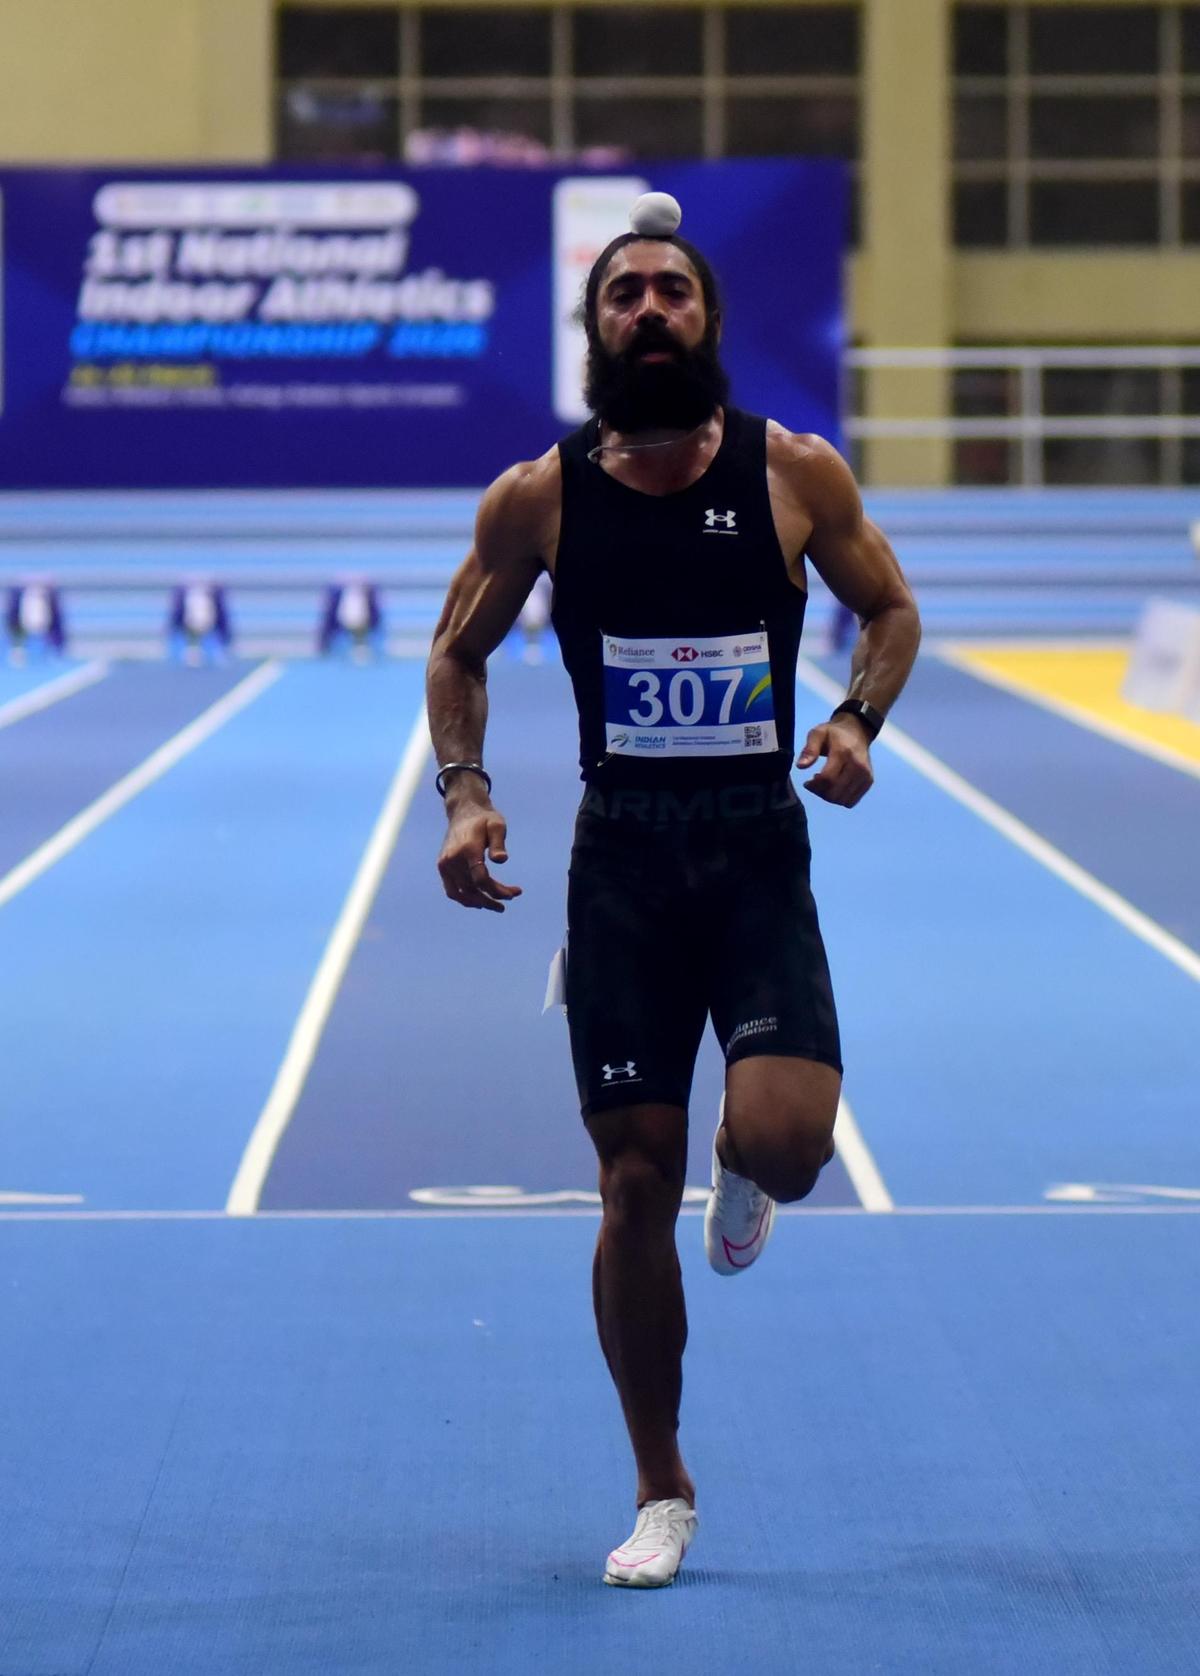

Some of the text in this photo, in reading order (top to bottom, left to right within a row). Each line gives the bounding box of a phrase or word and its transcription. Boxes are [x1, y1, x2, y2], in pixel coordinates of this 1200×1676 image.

[86, 229, 408, 278] 1st National
[78, 269, 494, 322] Indoor Athletics
[70, 322, 382, 358] CHAMPIONSHIP
[618, 646, 655, 657] Reliance
[701, 650, 724, 658] HSBC
[628, 668, 744, 727] 307
[634, 735, 666, 743] INDIAN
